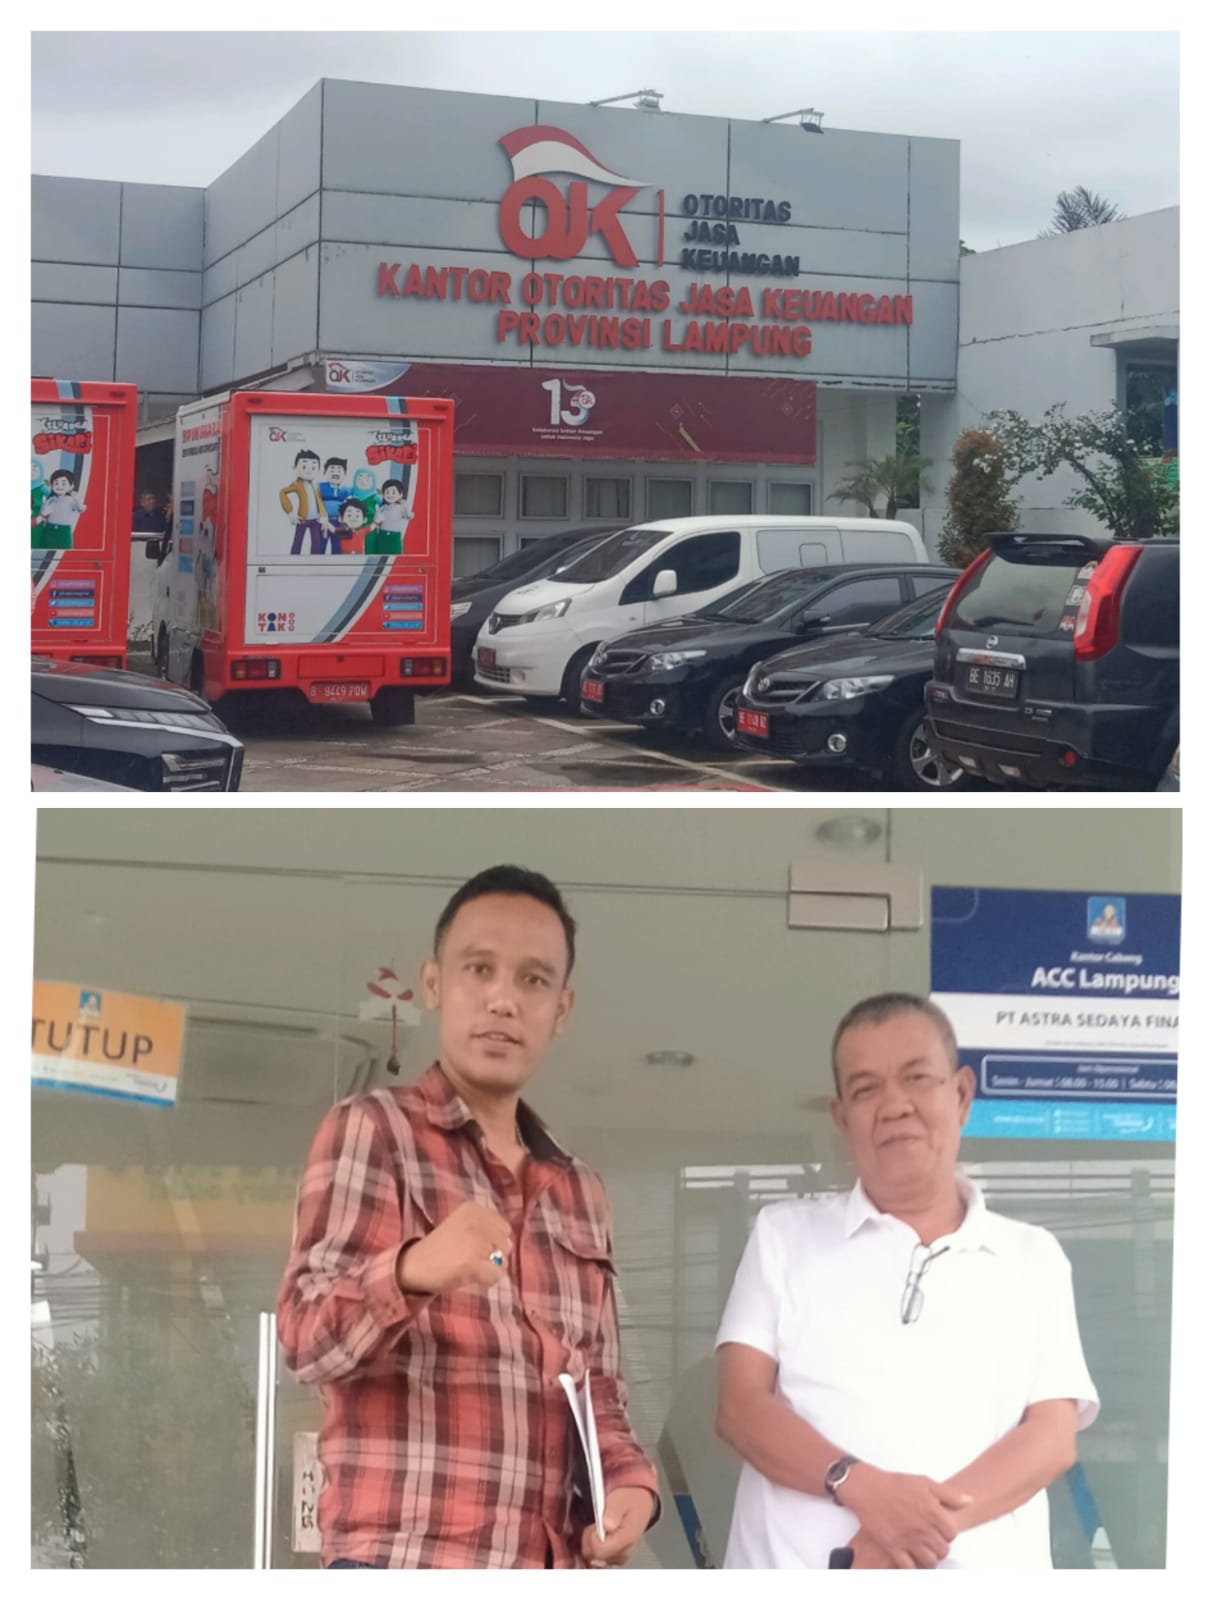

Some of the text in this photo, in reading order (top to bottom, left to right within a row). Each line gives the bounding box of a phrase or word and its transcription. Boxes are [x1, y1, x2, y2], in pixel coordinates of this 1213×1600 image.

[683, 194, 792, 222] OTORITAS
[683, 220, 740, 246] JASA
[681, 248, 800, 277] KEUANGAN
[378, 262, 913, 325] KANTOR OTORITAS JASA KEUANGAN
[497, 310, 812, 356] PROVINSI LAMPUNG
[968, 668, 1016, 689] BE 1635 AH
[1070, 951, 1143, 966] Kantor Cabang
[1031, 966, 1180, 995] ACC Lampung
[996, 1011, 1016, 1024] PT
[1020, 1011, 1072, 1026] ASTRA
[1076, 1013, 1141, 1028] SEDAYA
[32, 1018, 154, 1065] TUTUP
